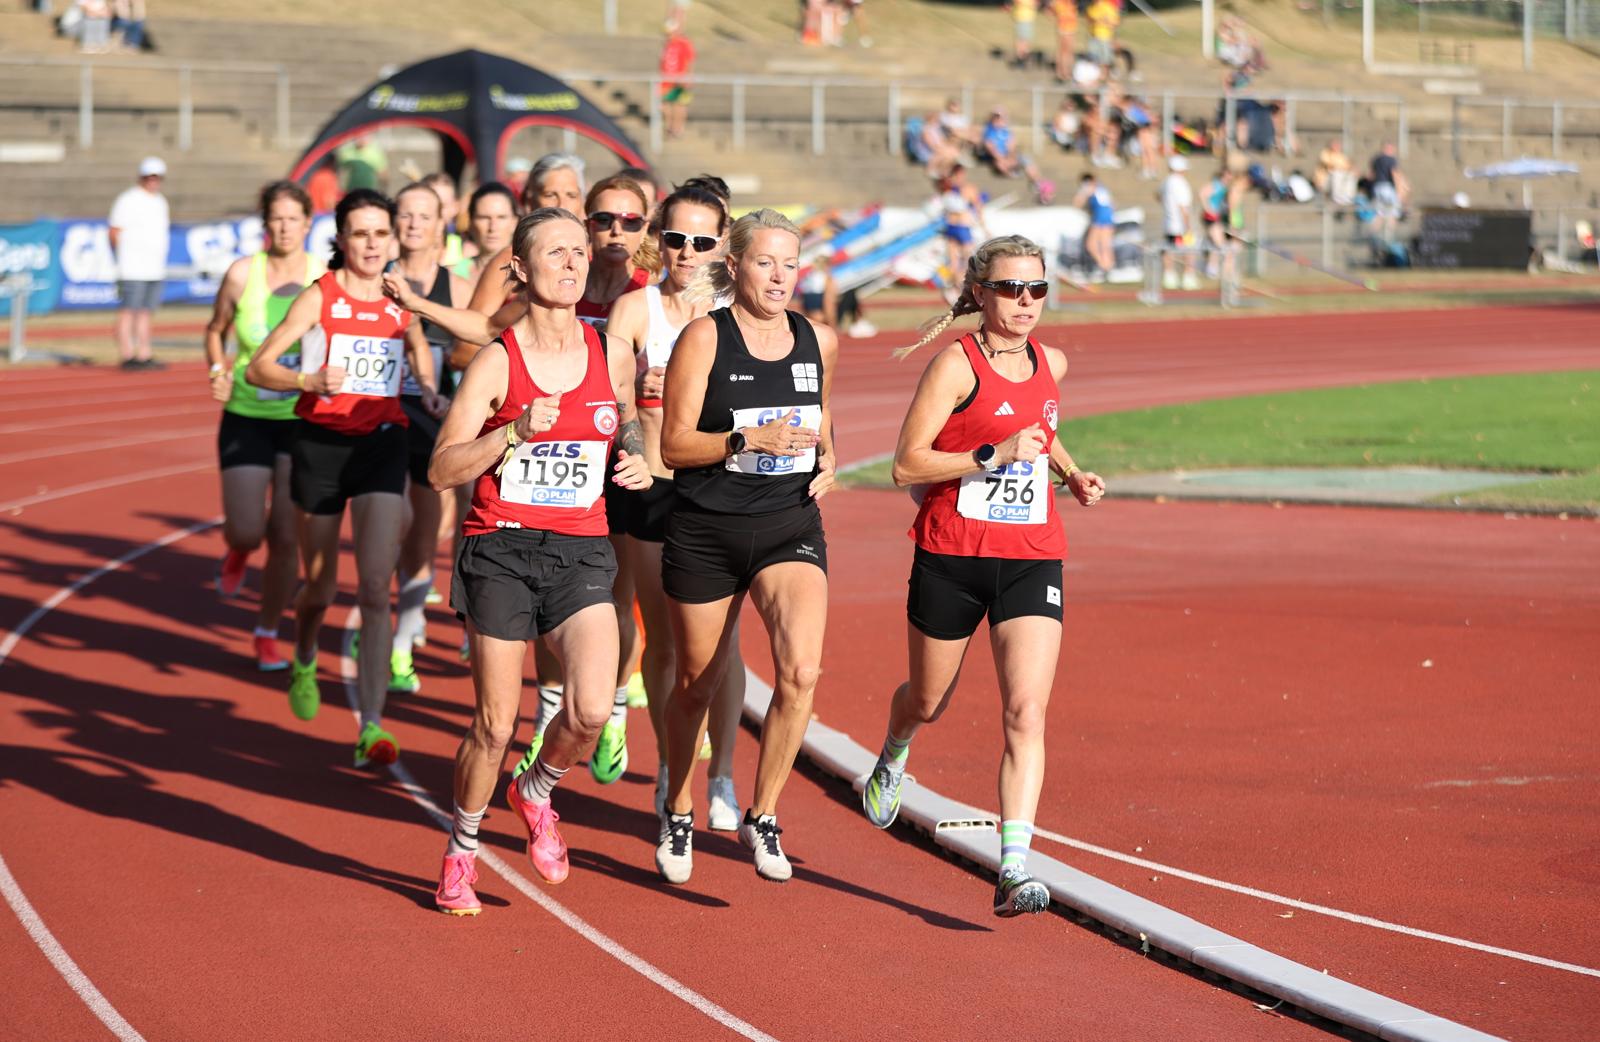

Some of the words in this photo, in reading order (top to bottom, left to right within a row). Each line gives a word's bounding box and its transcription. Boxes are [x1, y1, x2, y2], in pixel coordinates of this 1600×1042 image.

[353, 340, 389, 355] GLS
[343, 357, 396, 381] 1097
[531, 443, 581, 459] GLS
[519, 459, 588, 488] 1195
[550, 491, 575, 500] PLAN
[985, 477, 1034, 504] 756
